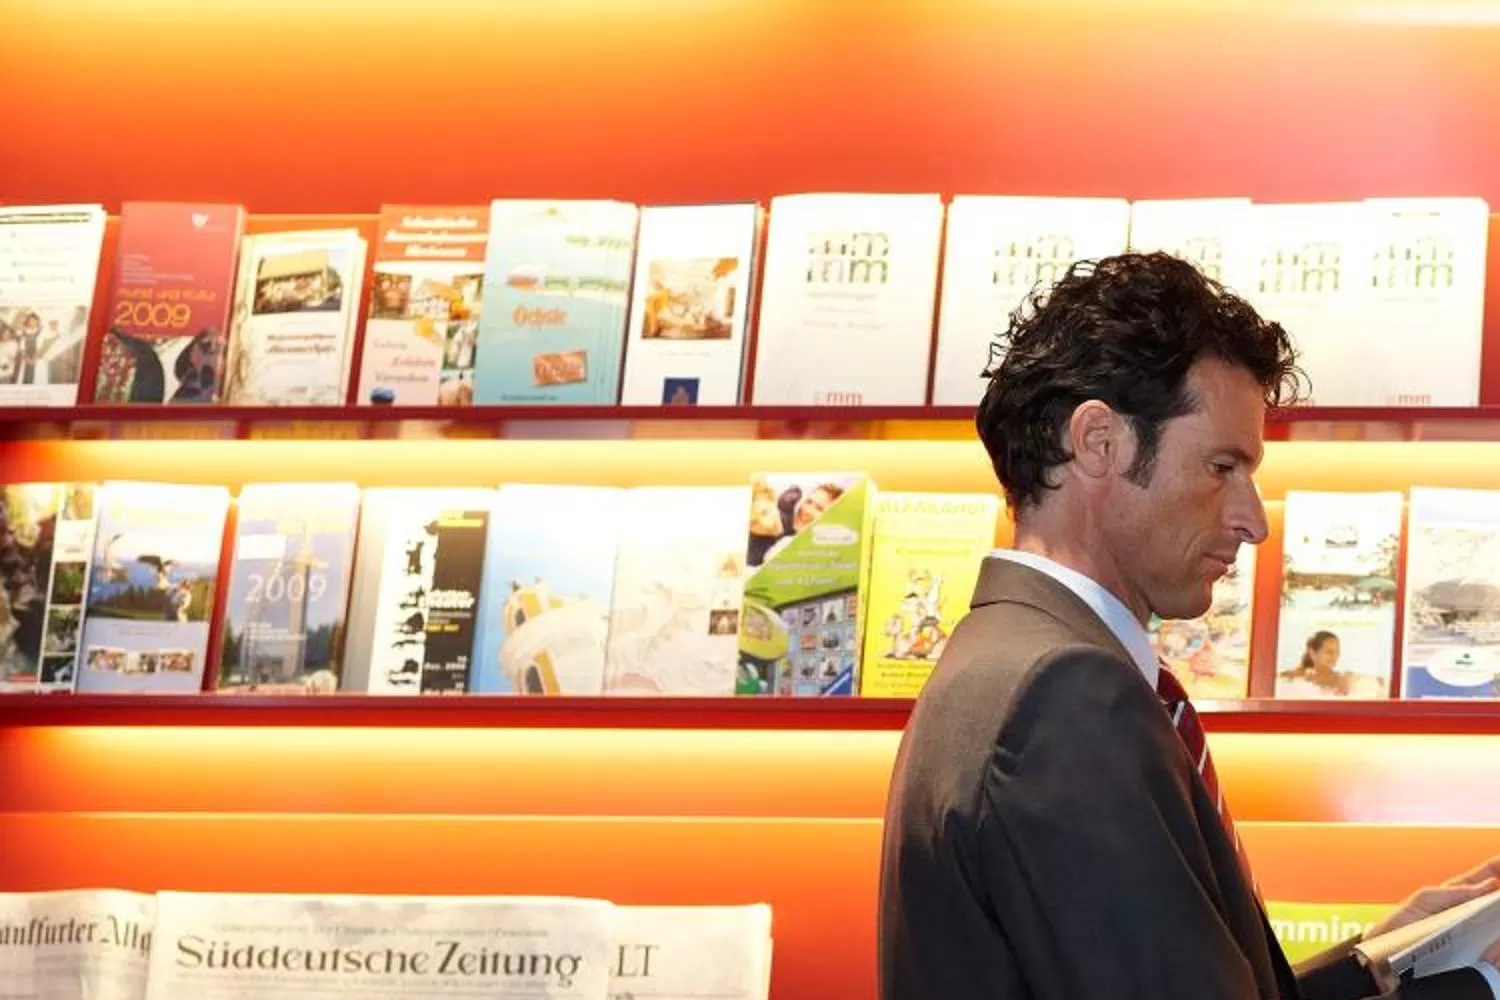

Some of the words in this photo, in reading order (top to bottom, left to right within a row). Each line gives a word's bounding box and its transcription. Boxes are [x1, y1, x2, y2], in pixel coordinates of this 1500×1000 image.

[115, 301, 192, 328] 2009
[245, 573, 328, 603] 2009
[1269, 914, 1374, 943] mmin
[175, 933, 430, 976] Süddeutsche
[436, 941, 584, 989] Zeitung
